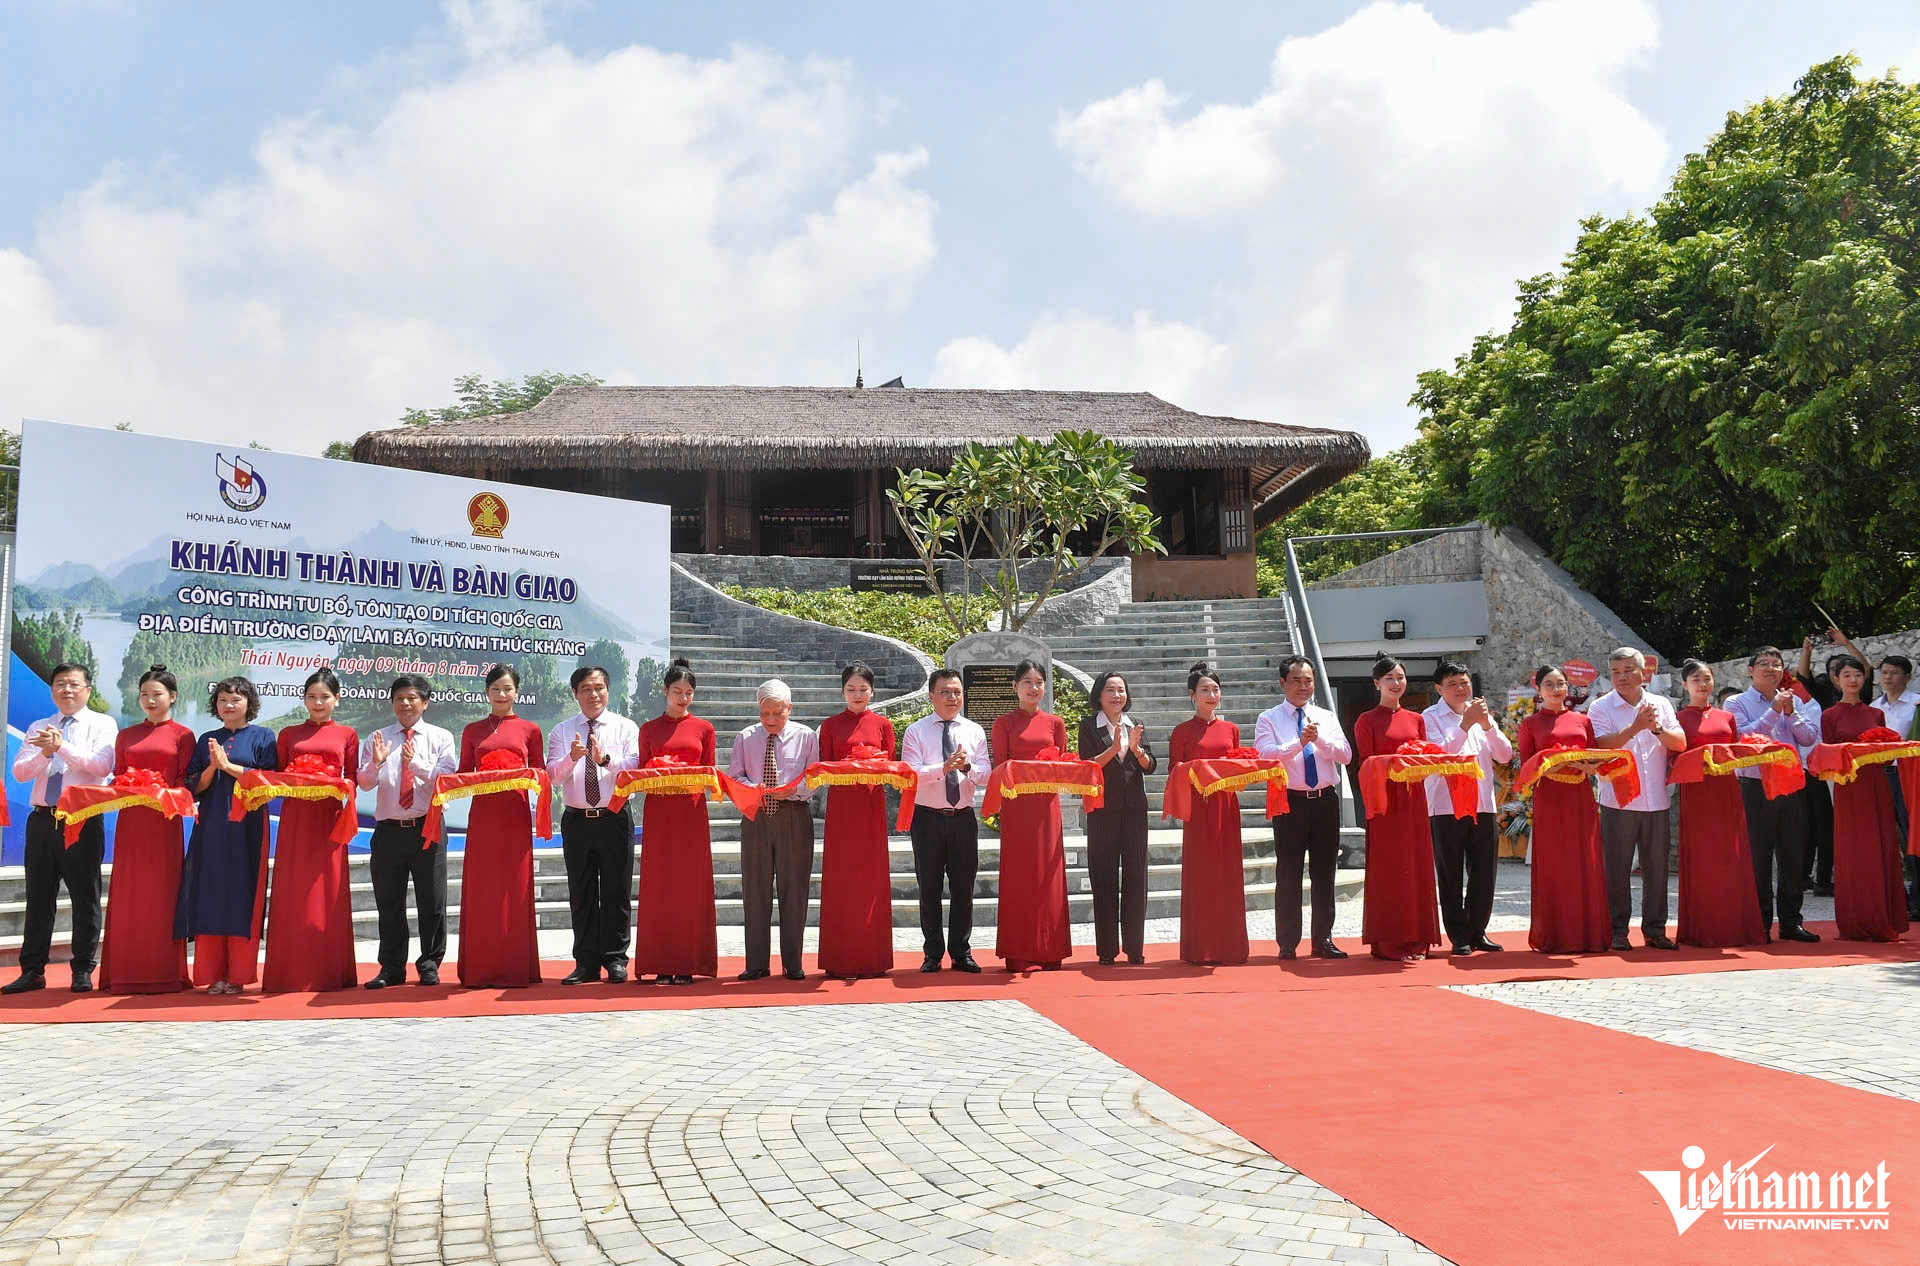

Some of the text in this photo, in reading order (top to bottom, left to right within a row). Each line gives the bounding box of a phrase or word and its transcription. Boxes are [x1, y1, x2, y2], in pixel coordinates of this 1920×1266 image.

[186, 512, 291, 530] HỘI NHÀ BÁO VIỆT NAM
[410, 535, 429, 545] TỈNH
[444, 541, 469, 550] HĐND,
[470, 543, 492, 552] UBND
[494, 544, 511, 554] TỈNH
[512, 546, 529, 556] THÁI
[529, 549, 560, 559] NGUYÊN
[170, 539, 577, 604] KHÁNH THÀNH VÀ BÀN GIAO
[177, 586, 563, 630] CÔNG TRÌNH TU BỔ, TÔN TẠO DI TÍCH QUỐC GIA
[139, 613, 585, 656] ĐỊA ĐIỂM TRƯỜNG DẠY LÀM BÁO HUỲNH THÚC KHÁNG
[241, 649, 274, 666] Thái
[275, 651, 334, 671] Nguyên,
[337, 656, 373, 675] ngày
[375, 656, 394, 672] 09
[396, 657, 435, 677] tháng
[438, 660, 447, 675] 8
[449, 660, 478, 676] năm
[257, 682, 279, 696] TÀI
[339, 686, 375, 699] ĐOÀN
[429, 688, 461, 703] QUỐC
[463, 692, 482, 704] GIA
